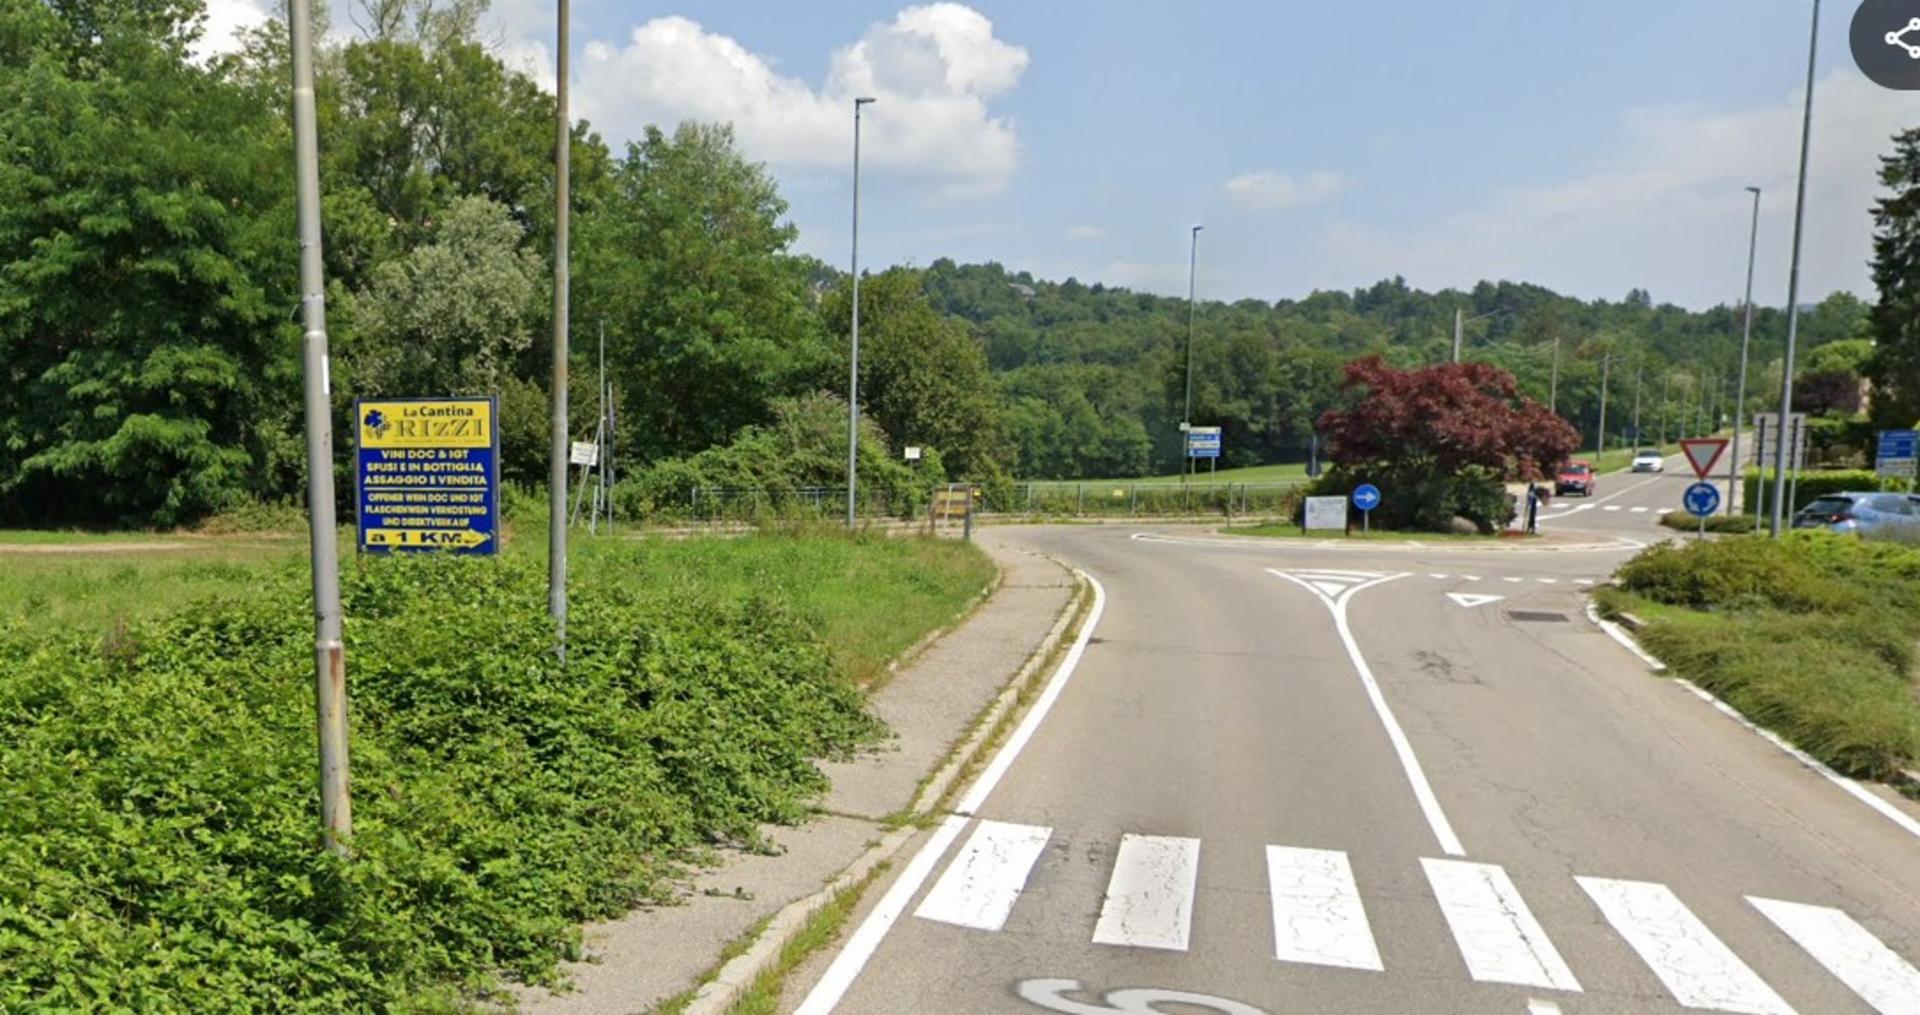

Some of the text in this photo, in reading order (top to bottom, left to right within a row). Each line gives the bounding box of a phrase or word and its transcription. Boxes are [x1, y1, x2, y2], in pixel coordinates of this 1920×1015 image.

[420, 406, 473, 416] Cantina
[381, 450, 469, 459] VINI DOC & IGT
[400, 463, 406, 472] E
[408, 463, 420, 472] IN
[423, 463, 484, 472] BOTTIGLIA
[364, 475, 487, 485] ASSAGGIO E VENDITA
[406, 493, 426, 501] WEIN
[428, 493, 448, 501] DOC
[450, 494, 467, 502] UND
[470, 494, 484, 502] IGT
[365, 505, 487, 514] FLASCHENWEIN VERKOSTUNG
[383, 517, 400, 526] UND
[371, 533, 385, 542] a
[396, 532, 407, 542] 1
